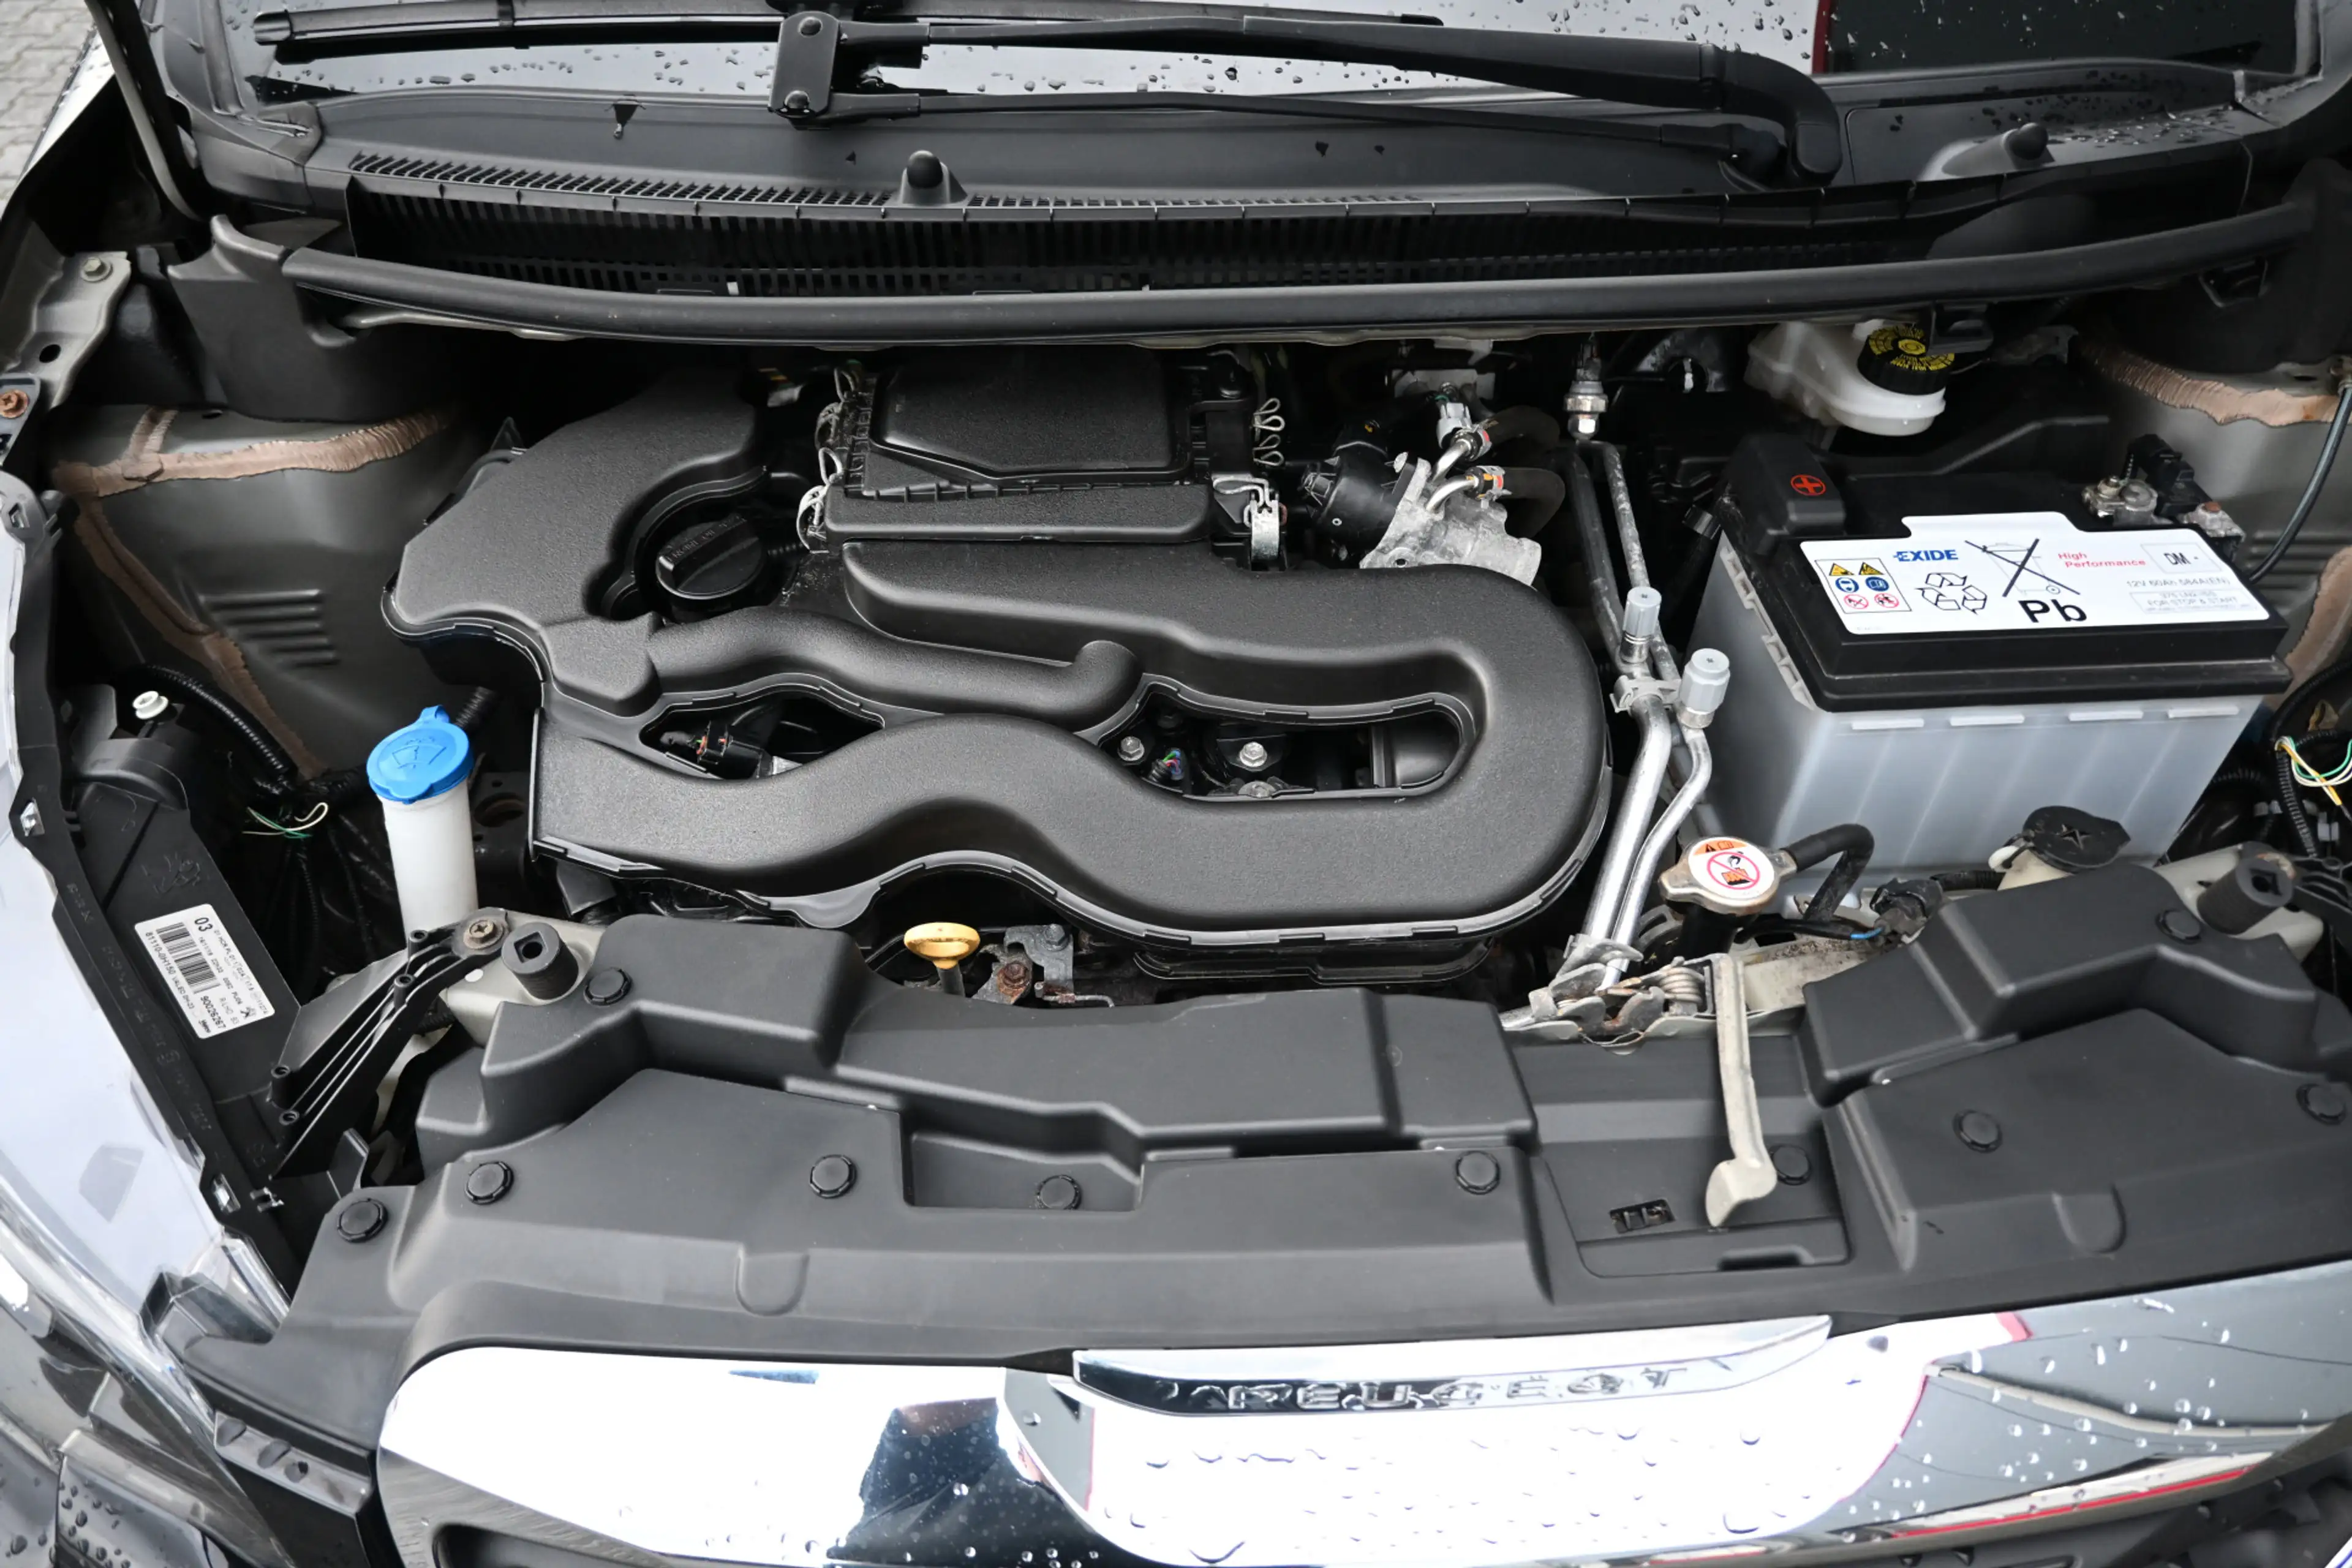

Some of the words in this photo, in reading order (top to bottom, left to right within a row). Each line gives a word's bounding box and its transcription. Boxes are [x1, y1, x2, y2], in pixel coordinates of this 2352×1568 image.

[1893, 549, 1959, 562] EXIDE
[2057, 552, 2087, 560] High
[2065, 559, 2146, 568] Performance
[2018, 599, 2087, 623] Pb
[194, 916, 214, 932] 03
